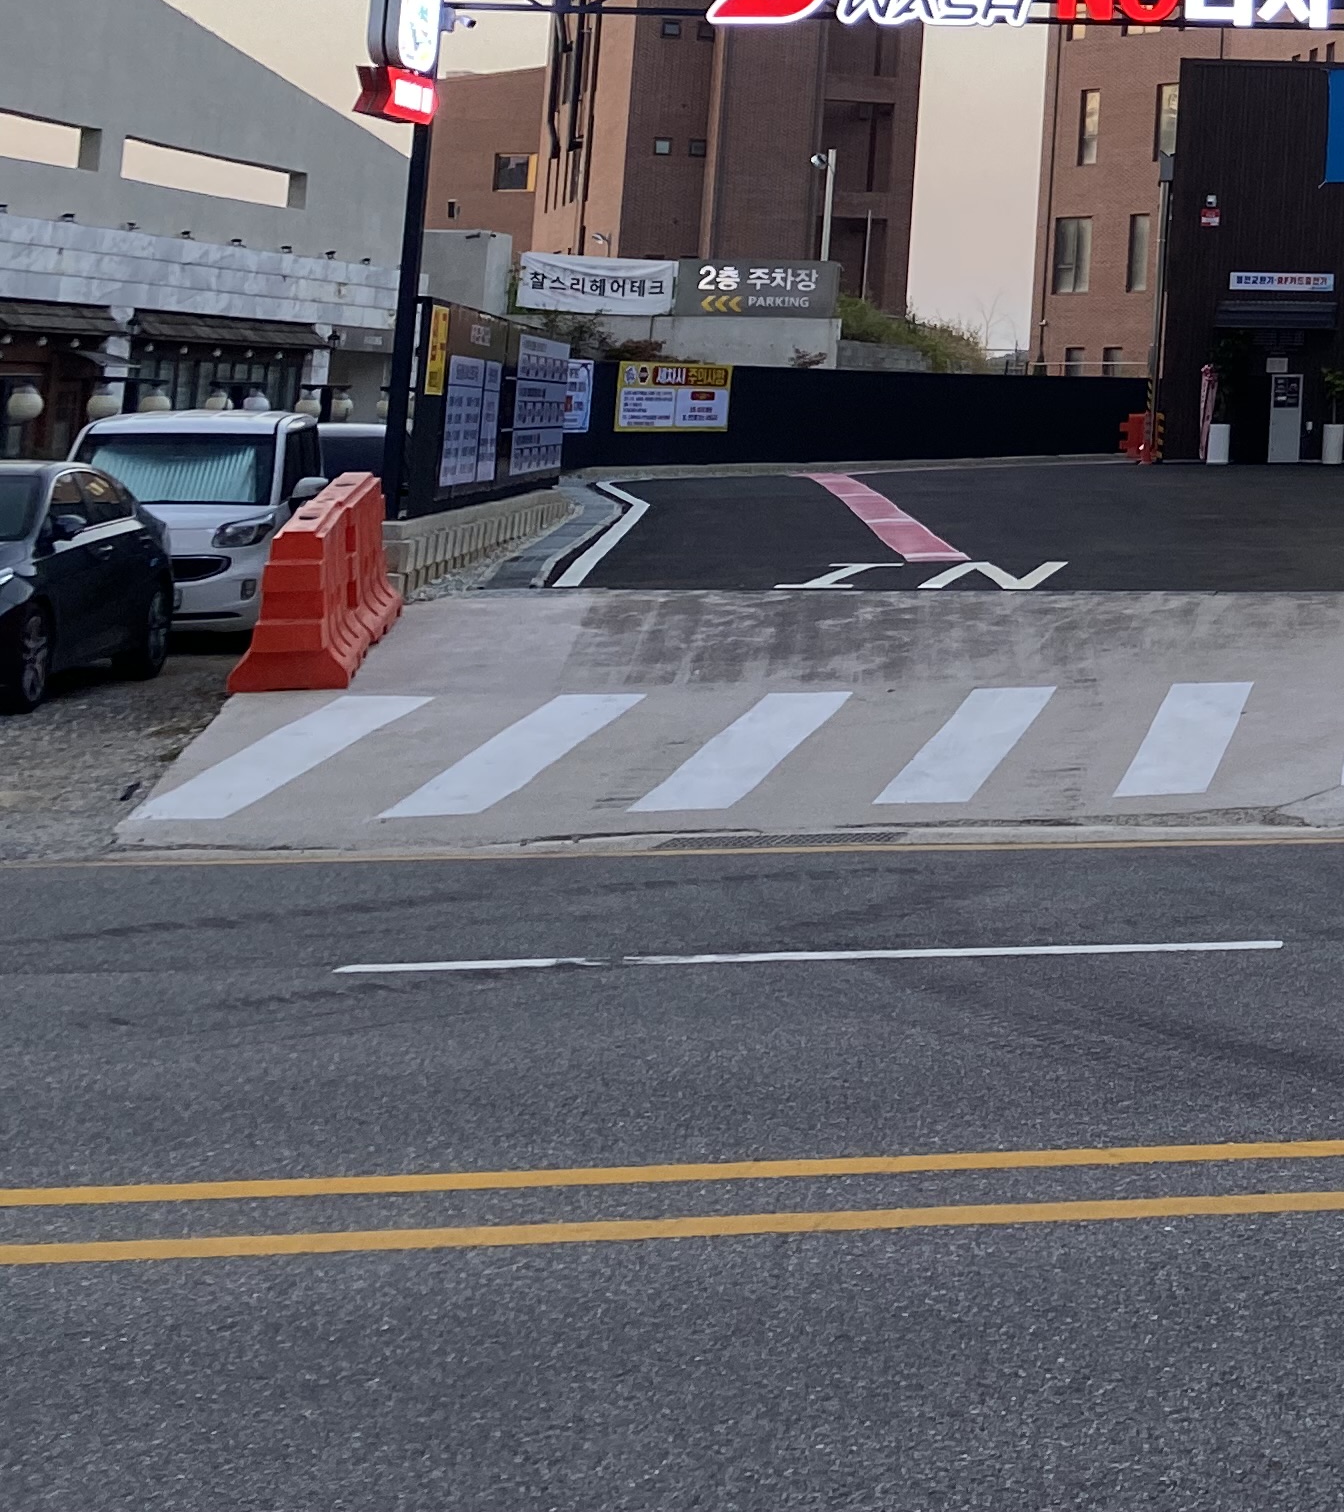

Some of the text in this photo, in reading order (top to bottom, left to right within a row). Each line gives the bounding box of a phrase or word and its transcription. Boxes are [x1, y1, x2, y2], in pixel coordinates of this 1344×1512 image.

[529, 271, 664, 298] 찰스리헤어테크
[697, 265, 819, 291] 2층 주차장
[747, 295, 810, 309] PARKING
[773, 560, 1069, 590] IN
